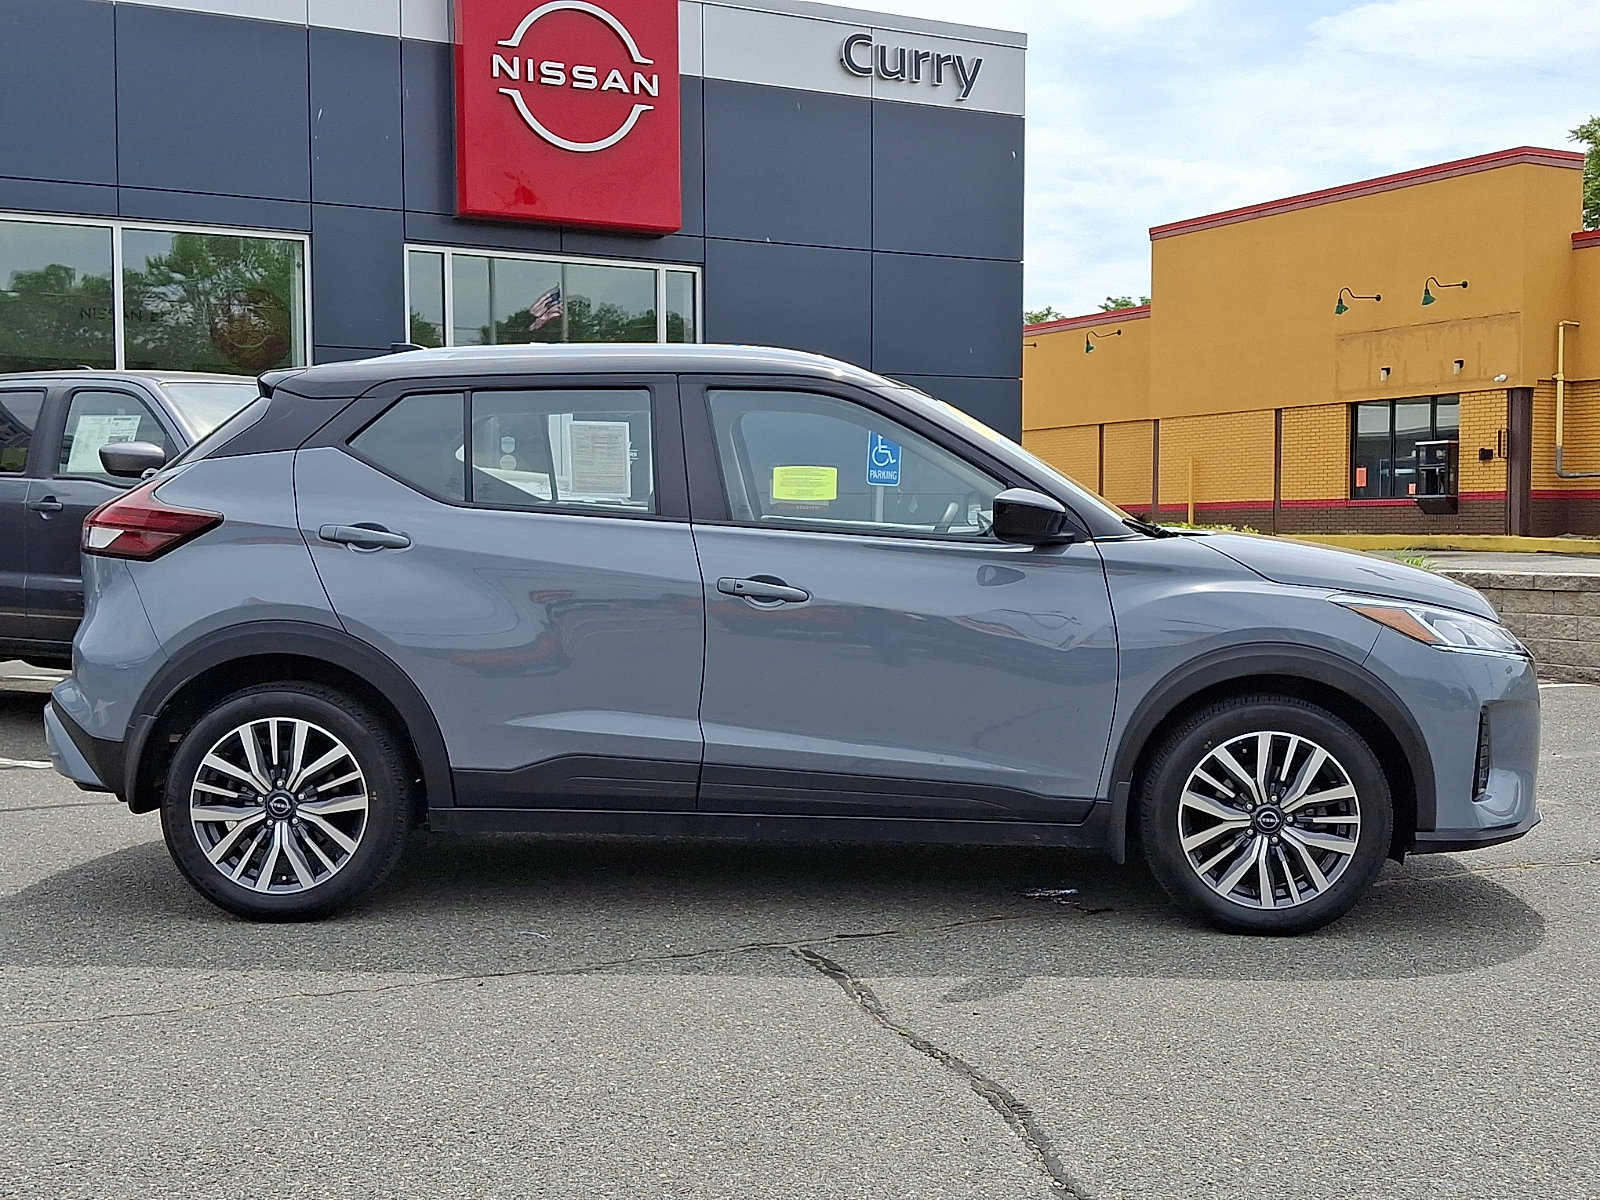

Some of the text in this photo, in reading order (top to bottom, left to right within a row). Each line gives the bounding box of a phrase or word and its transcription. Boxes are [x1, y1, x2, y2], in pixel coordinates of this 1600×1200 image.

[492, 53, 659, 97] NISSAN
[840, 32, 983, 100] Curry
[80, 306, 142, 322] NISN
[869, 469, 898, 480] PARKING
